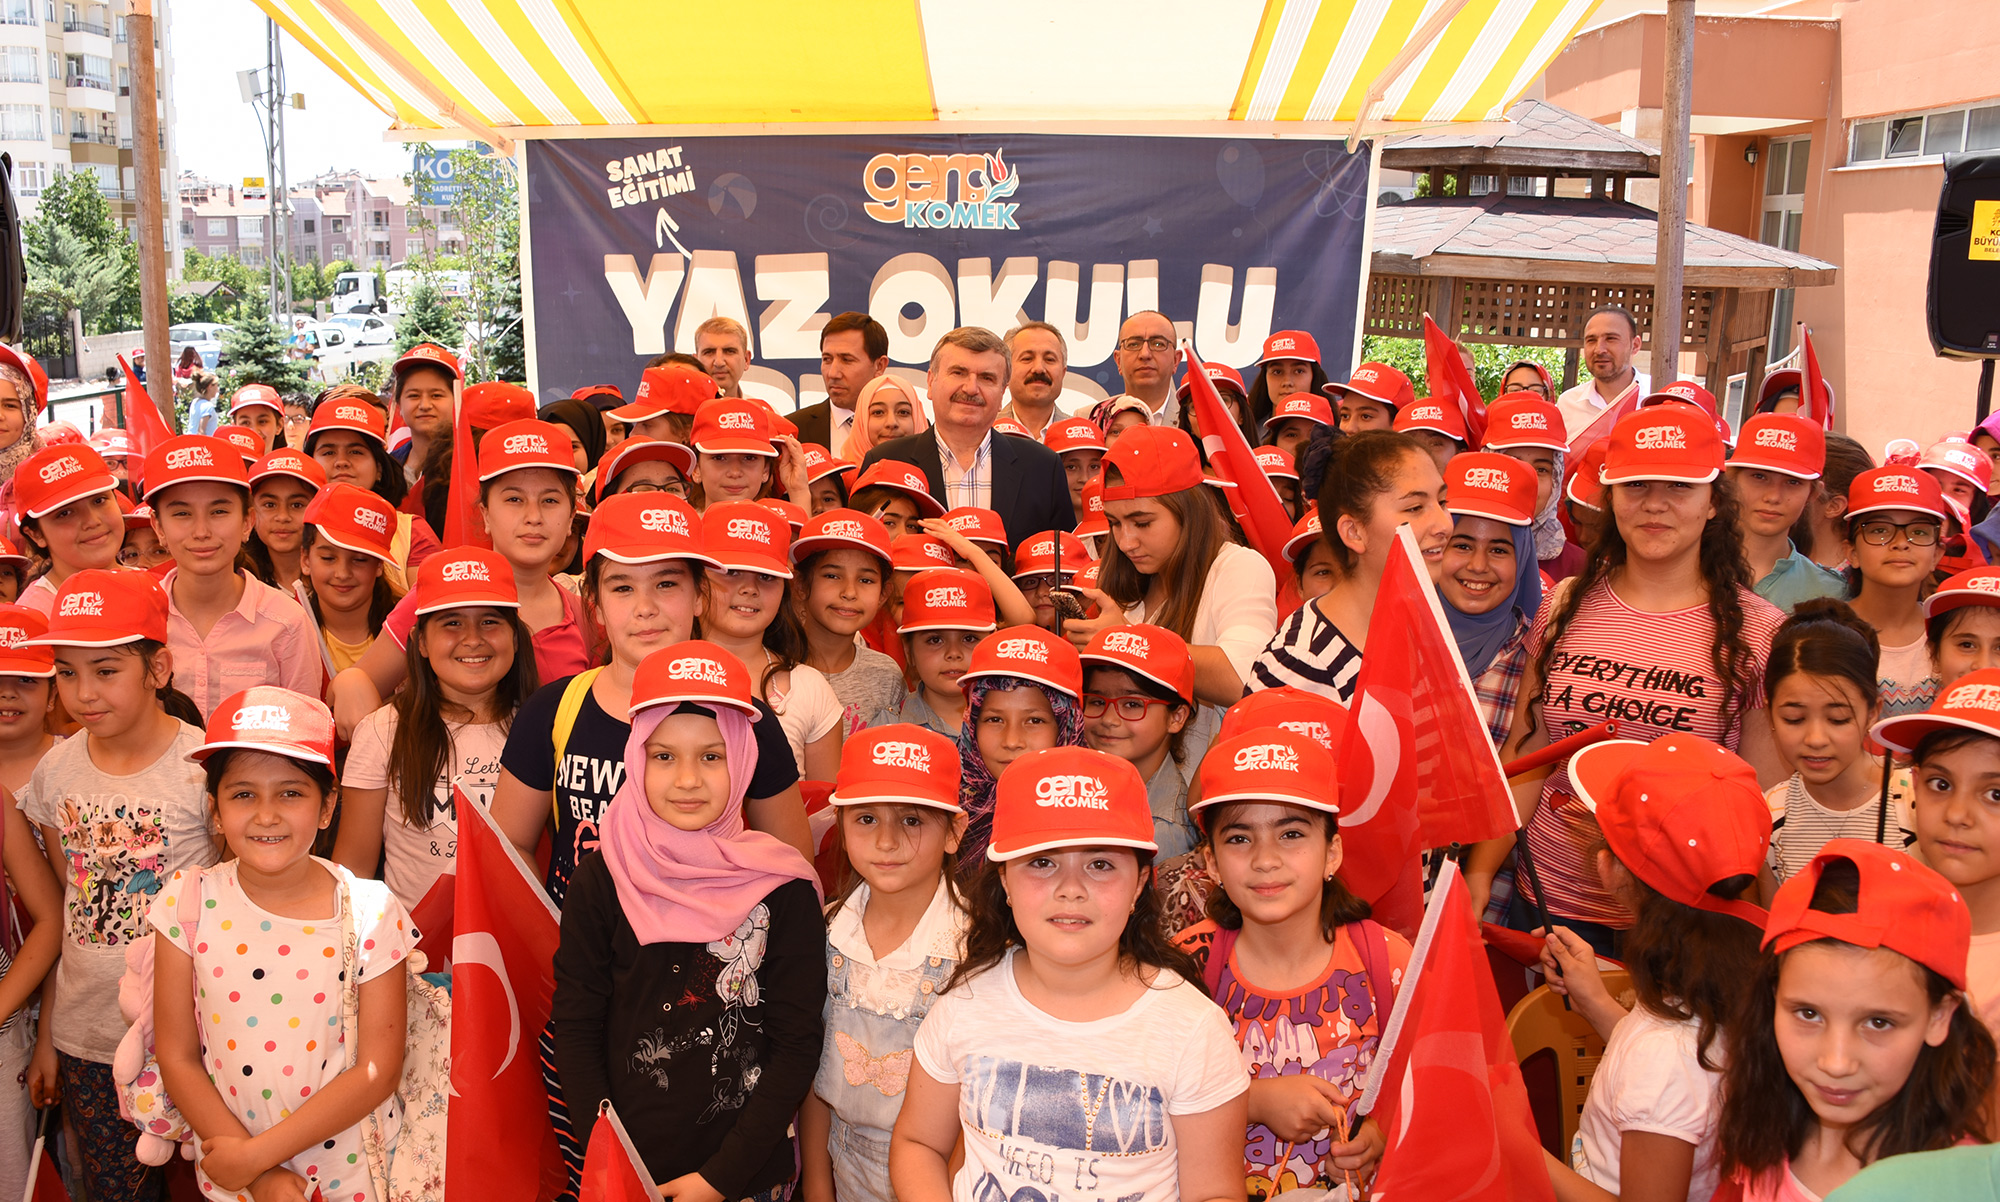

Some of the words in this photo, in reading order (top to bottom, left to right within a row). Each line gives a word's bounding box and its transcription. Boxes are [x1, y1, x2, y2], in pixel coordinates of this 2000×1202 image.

[606, 145, 683, 182] SANAT
[607, 165, 696, 209] EĞİTİMİ
[904, 202, 1020, 229] KOMEK
[604, 250, 833, 360] YAZ
[870, 252, 1277, 367] OKULU
[684, 671, 727, 687] KOMEK
[1549, 652, 1706, 698] EVERYTHING
[1582, 692, 1697, 731] CHOICE
[557, 754, 625, 795] NEW
[888, 756, 930, 774] KOMEK
[1250, 758, 1299, 772] KOMEK
[1055, 797, 1108, 811] KOMEK
